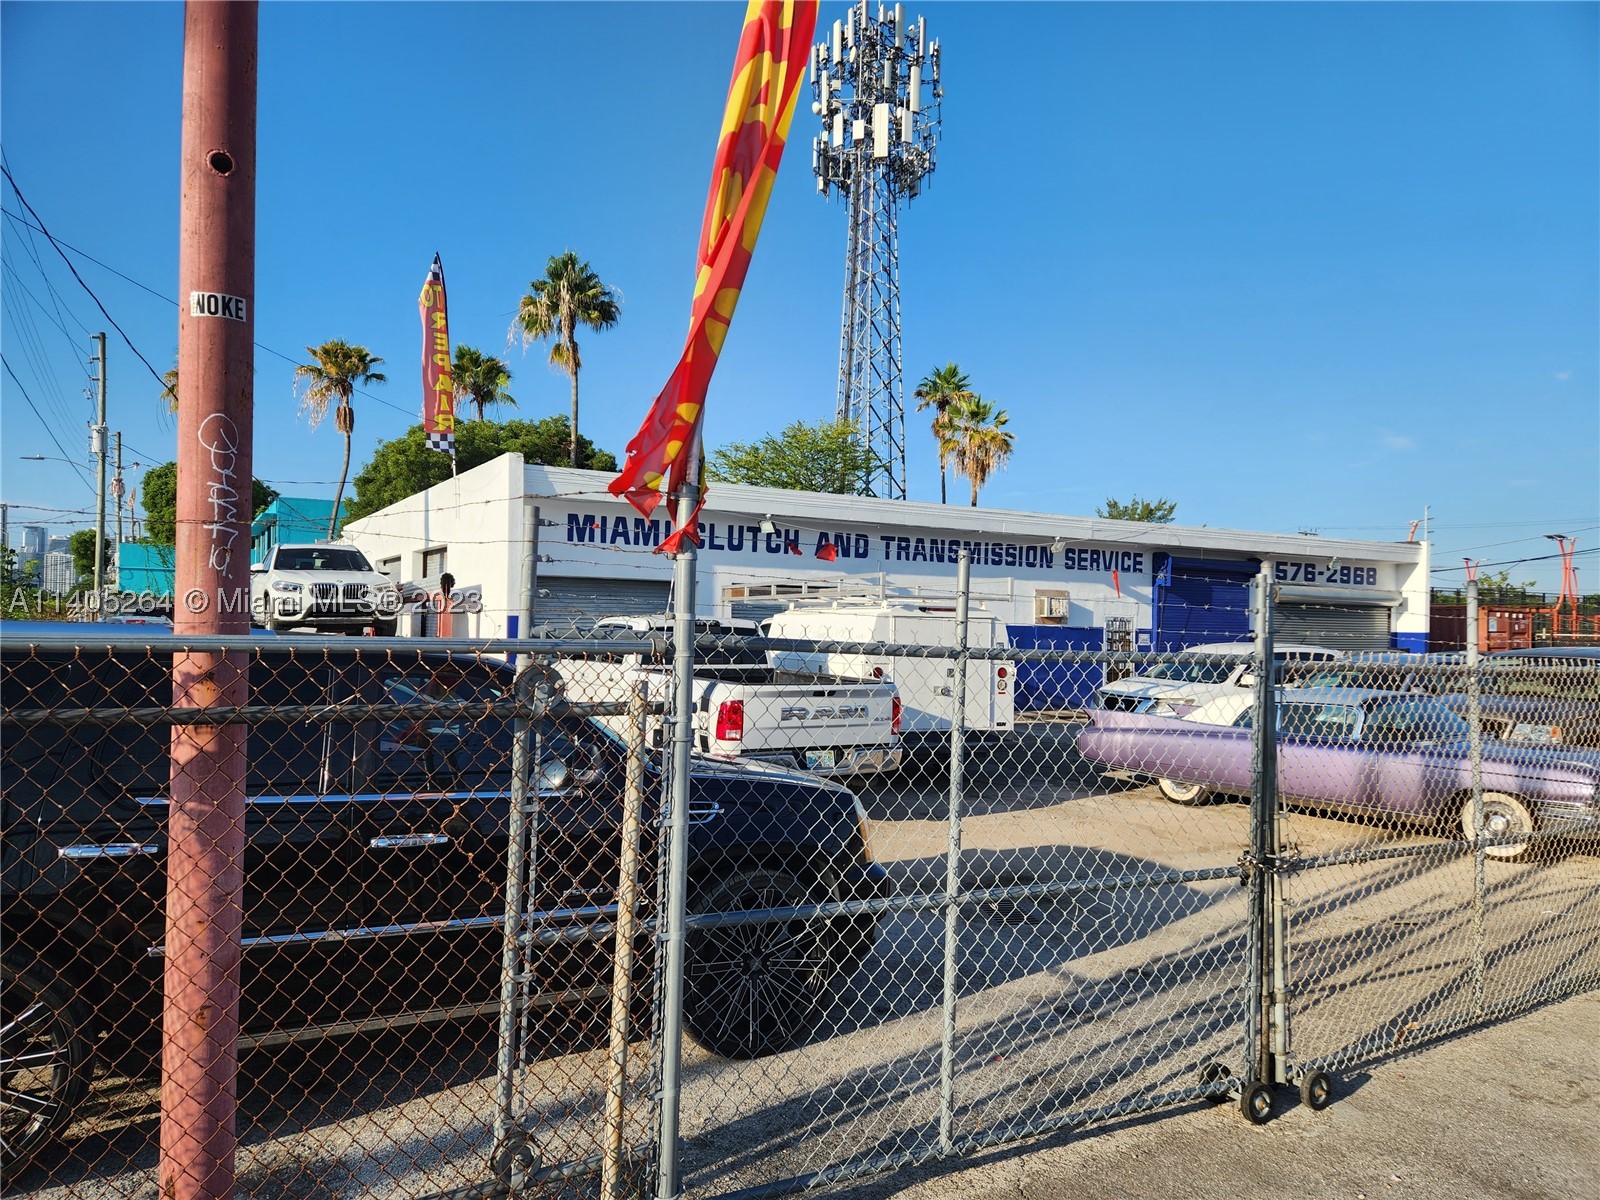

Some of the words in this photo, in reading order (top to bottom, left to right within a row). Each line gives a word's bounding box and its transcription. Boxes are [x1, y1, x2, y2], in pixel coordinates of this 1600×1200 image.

[196, 293, 244, 320] NOKE
[567, 513, 671, 547] MIAMI
[815, 531, 869, 559] AND
[880, 535, 1053, 569] TRANSMISSION
[1065, 548, 1144, 573] SERVICE
[1275, 561, 1377, 586] 576-2968
[780, 705, 869, 721] RAM
